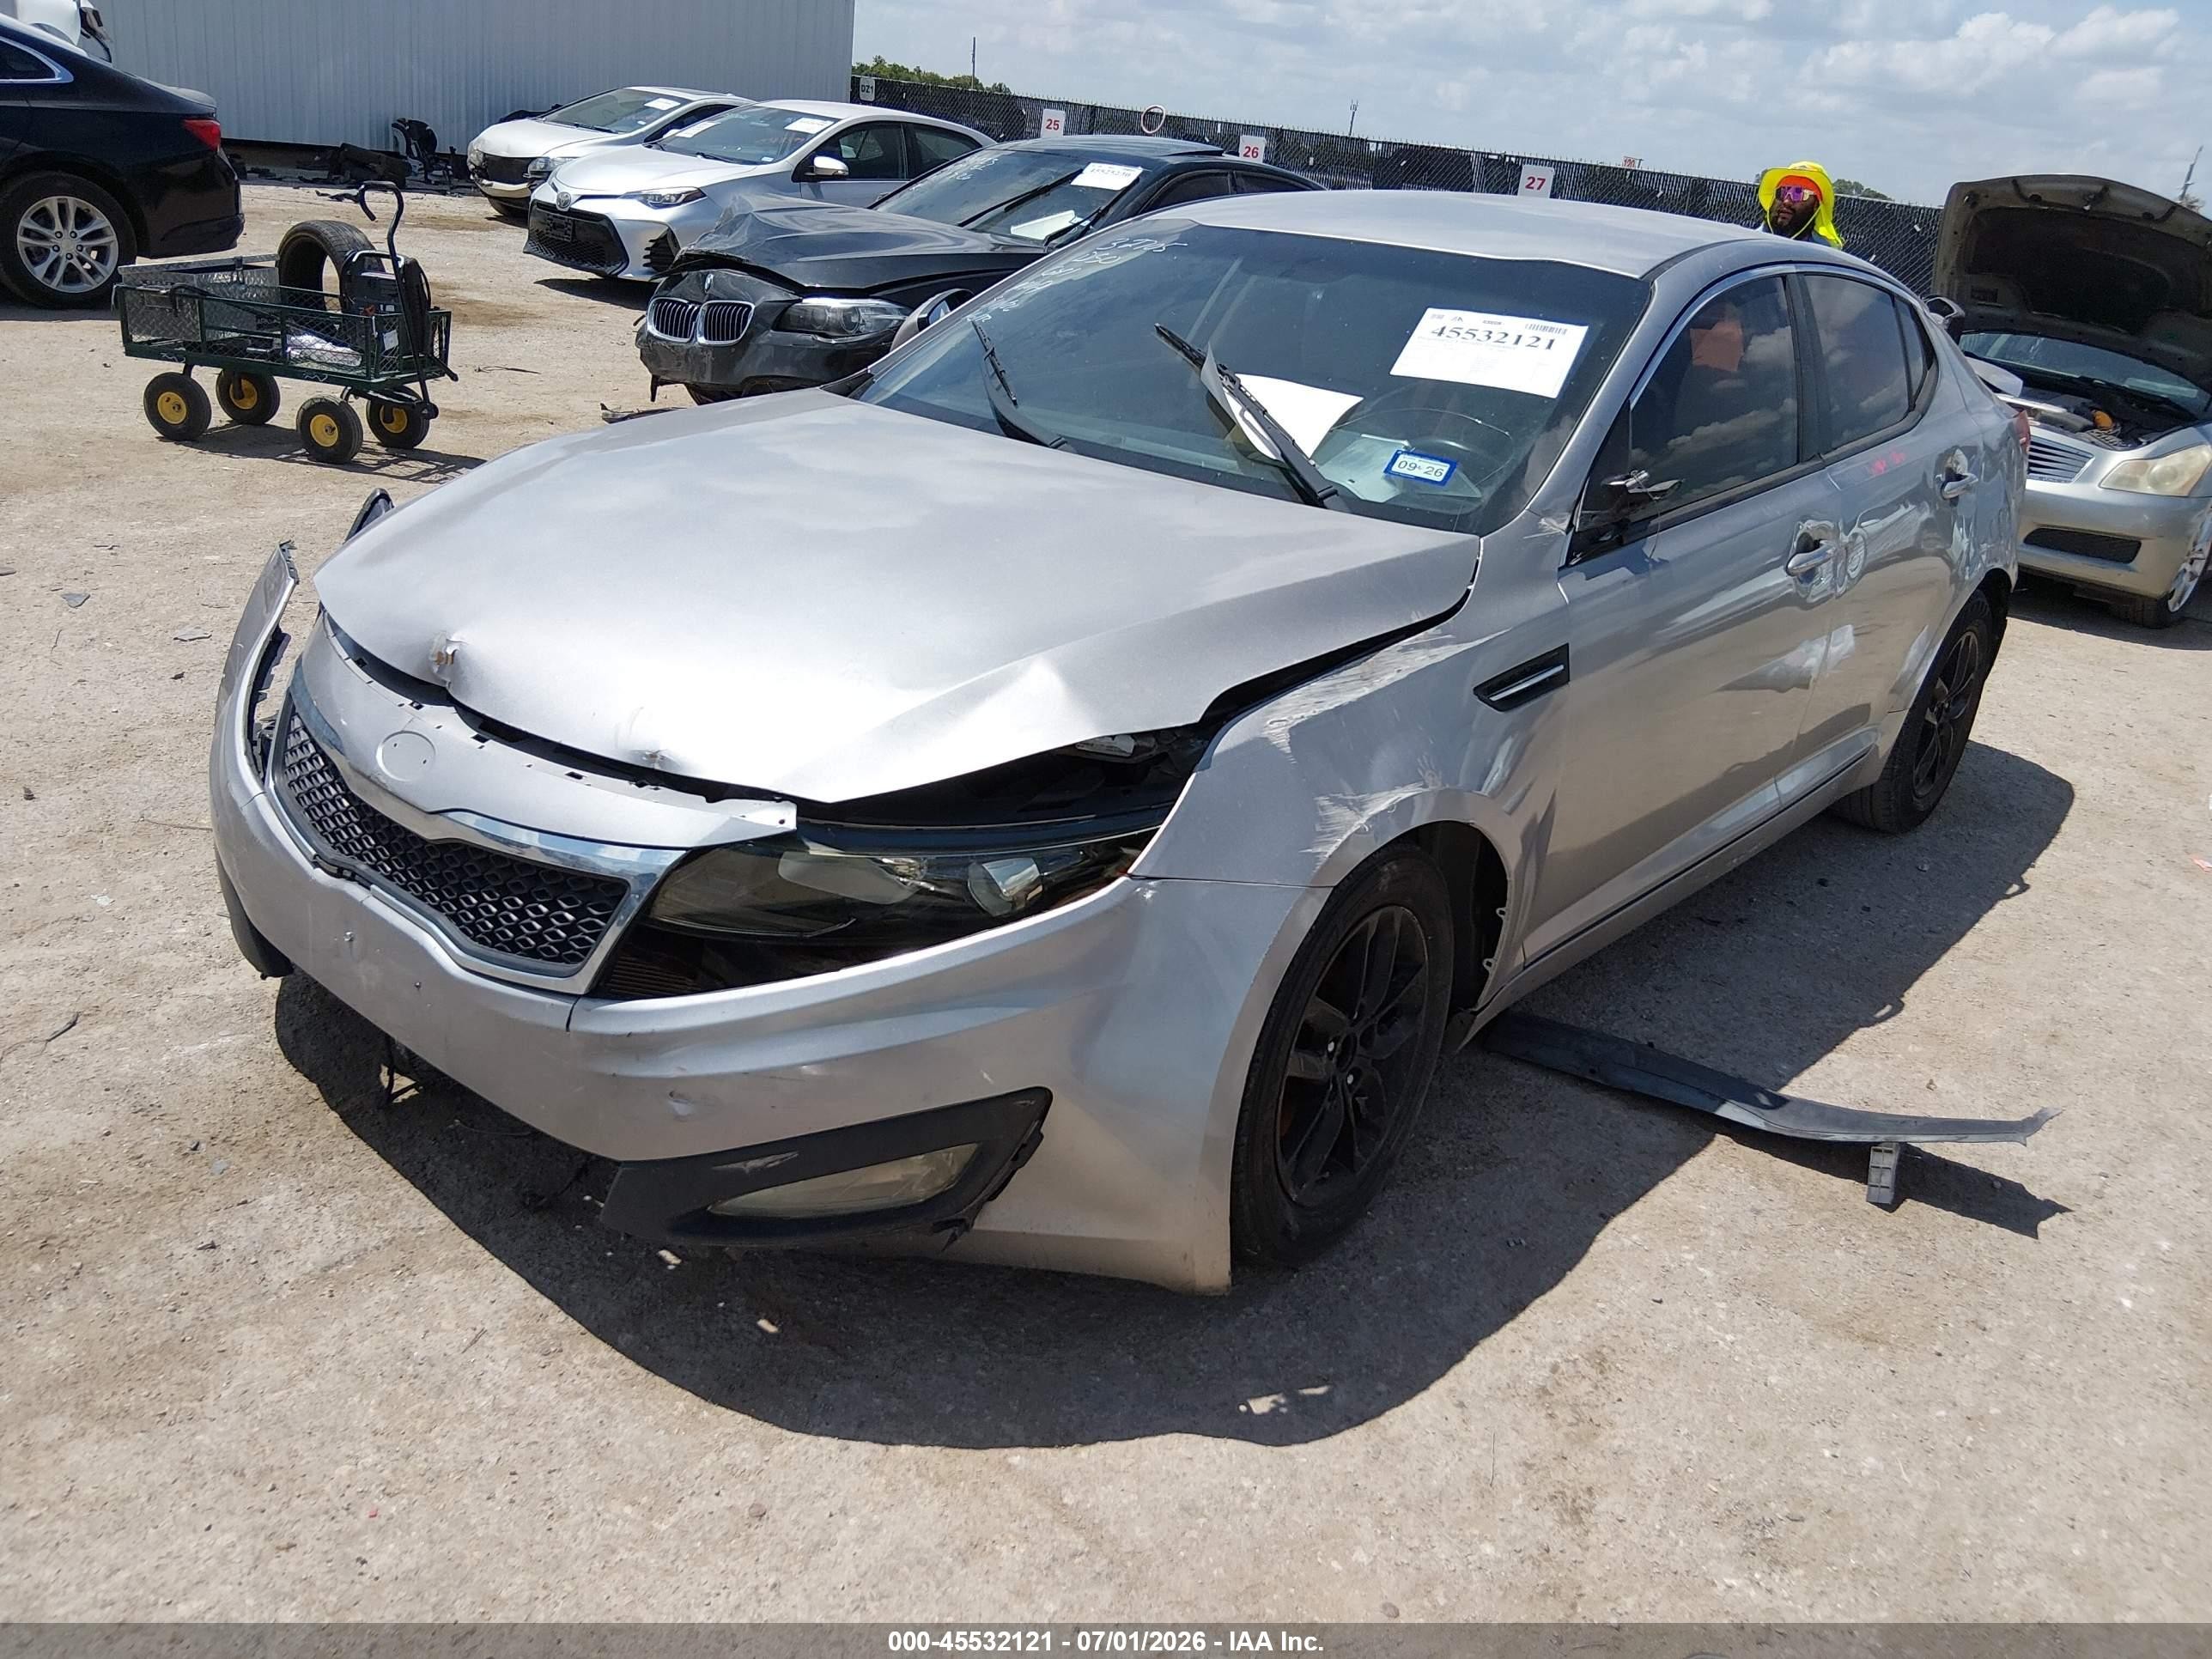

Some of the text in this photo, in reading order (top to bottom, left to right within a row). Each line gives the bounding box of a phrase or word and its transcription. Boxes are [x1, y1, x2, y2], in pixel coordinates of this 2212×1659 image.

[860, 84, 873, 94] DZ1
[1045, 118, 1060, 131] 25
[1243, 145, 1260, 159] 26
[1525, 176, 1547, 191] 27
[1430, 325, 1556, 350] 45532121
[1397, 460, 1444, 477] 09 26
